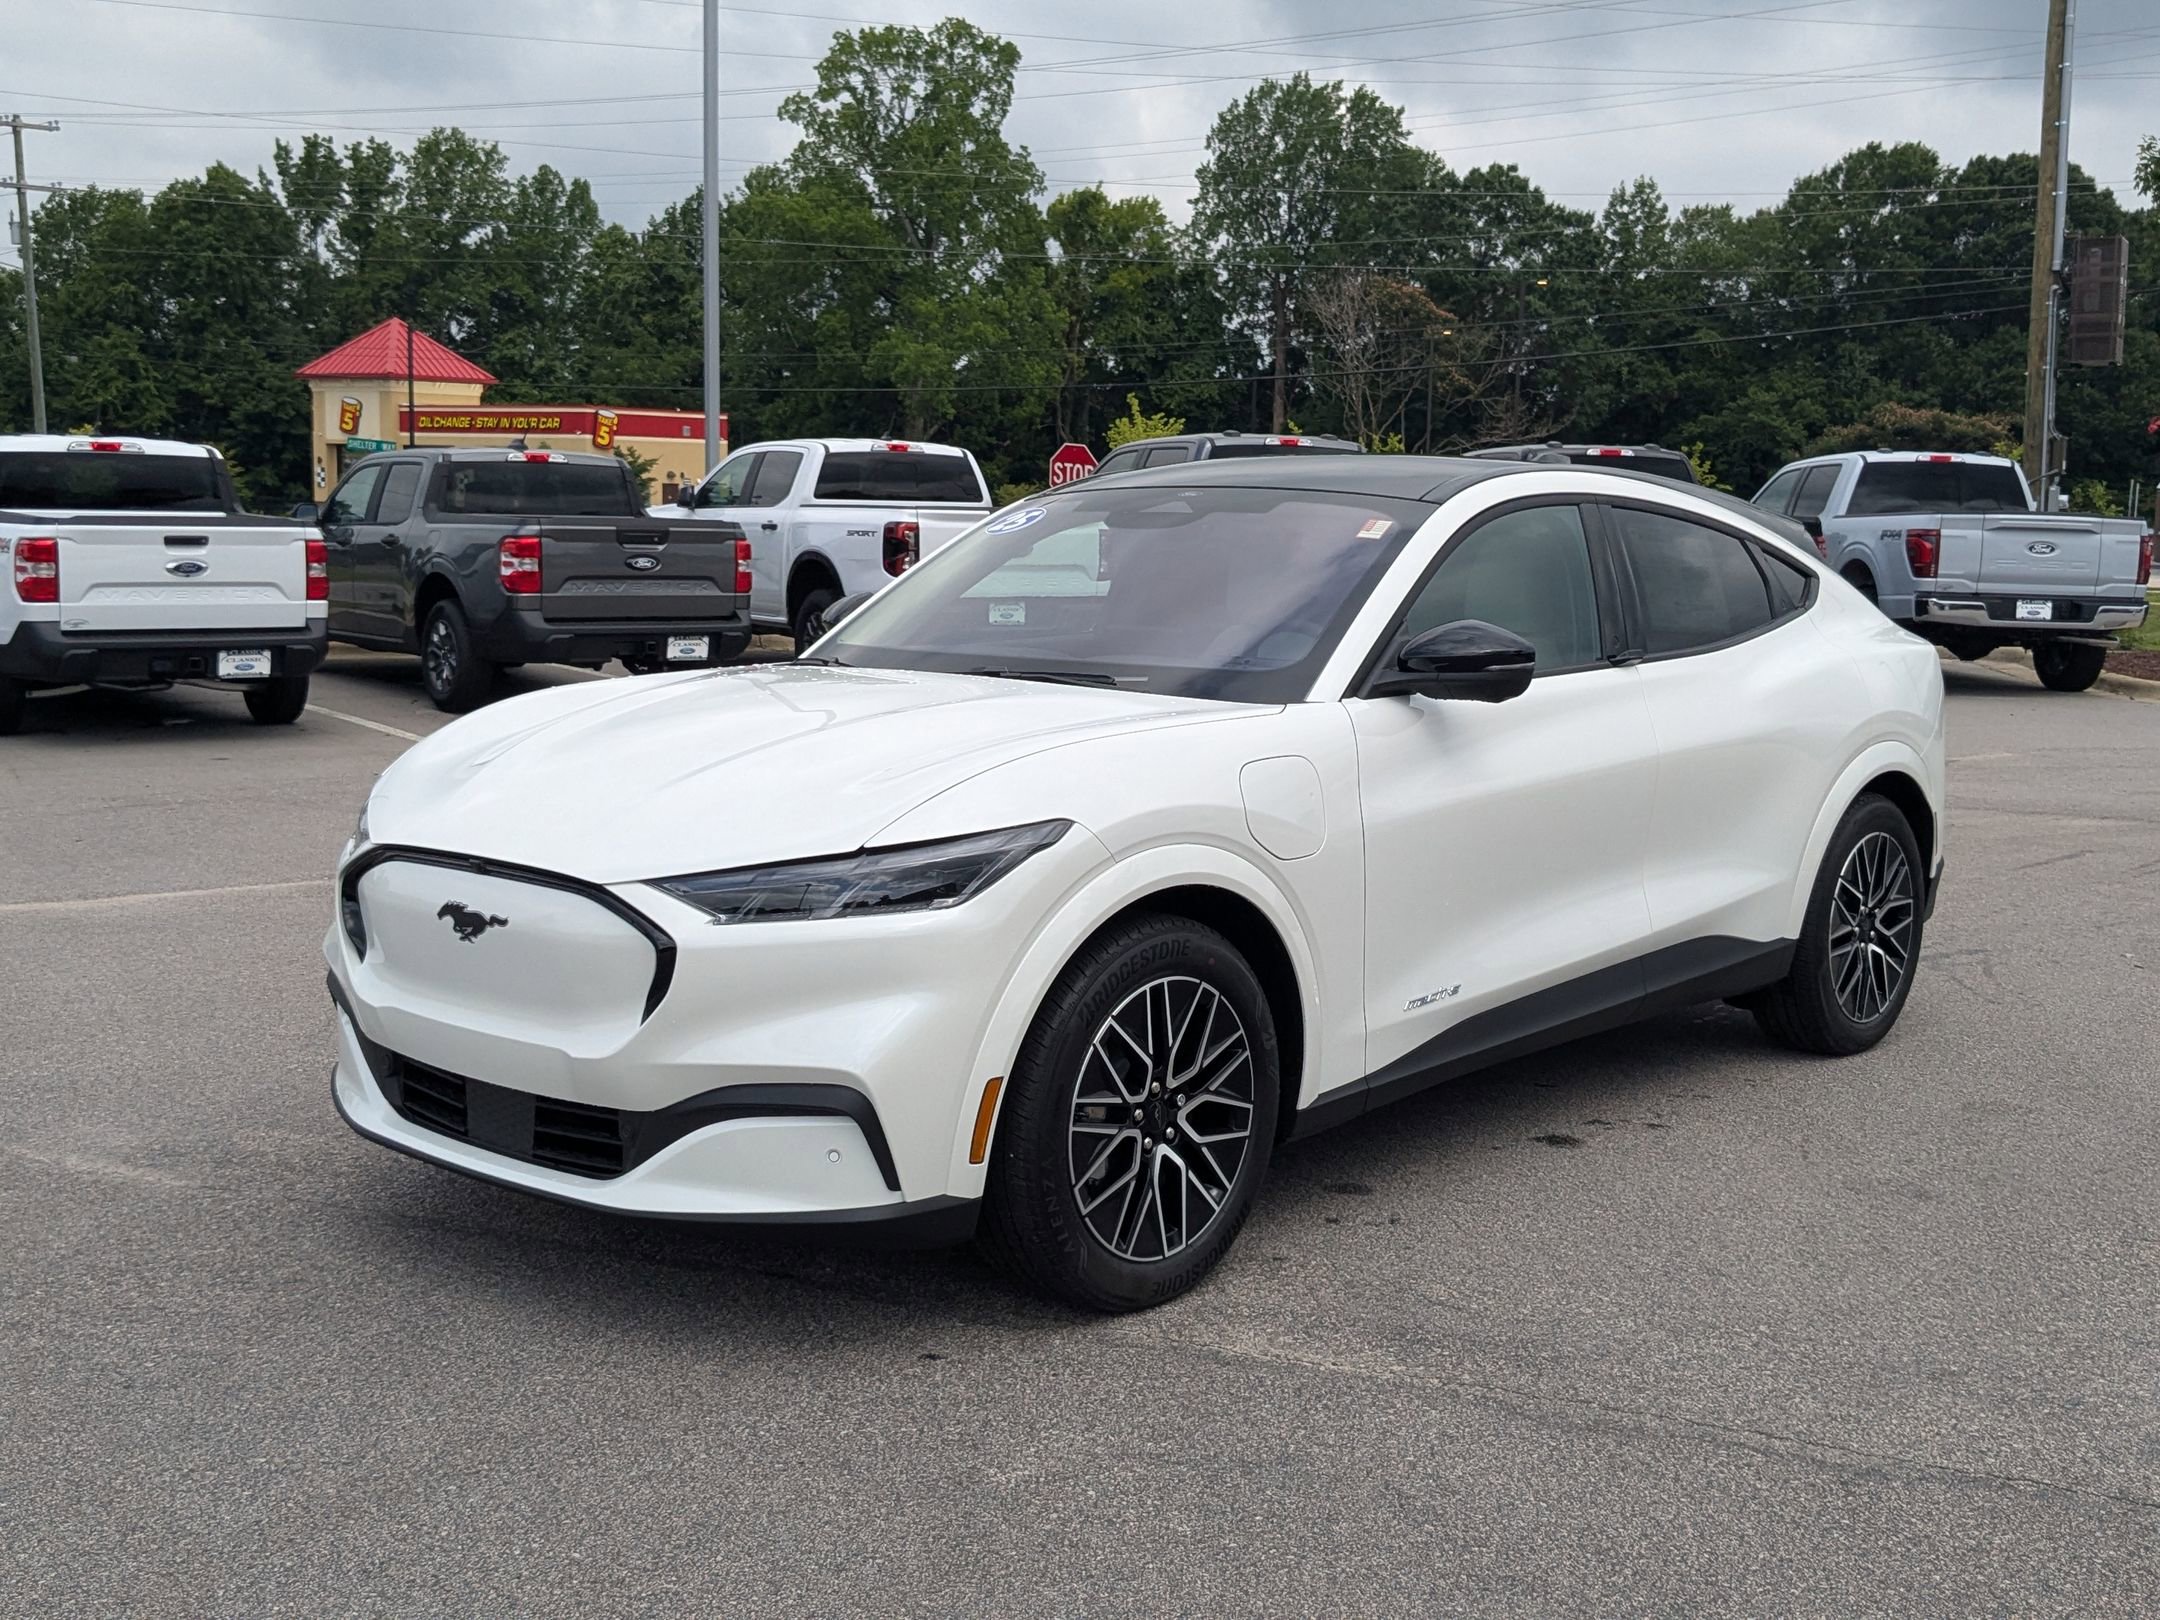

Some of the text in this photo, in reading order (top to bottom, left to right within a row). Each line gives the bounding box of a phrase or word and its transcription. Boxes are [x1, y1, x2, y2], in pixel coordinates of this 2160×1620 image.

[341, 411, 354, 431] 5
[418, 416, 432, 428] OIL
[433, 416, 471, 428] CHANGE
[475, 417, 497, 428] STAY
[499, 417, 510, 429] IN
[539, 417, 561, 429] CAR
[597, 425, 610, 446] 5
[348, 439, 396, 451] SHELTER WAY
[846, 529, 878, 538] SPORT
[97, 588, 273, 600] MAVERICK
[571, 582, 710, 594] MAVERICK
[1078, 938, 1192, 1028] BRIDGESTONE
